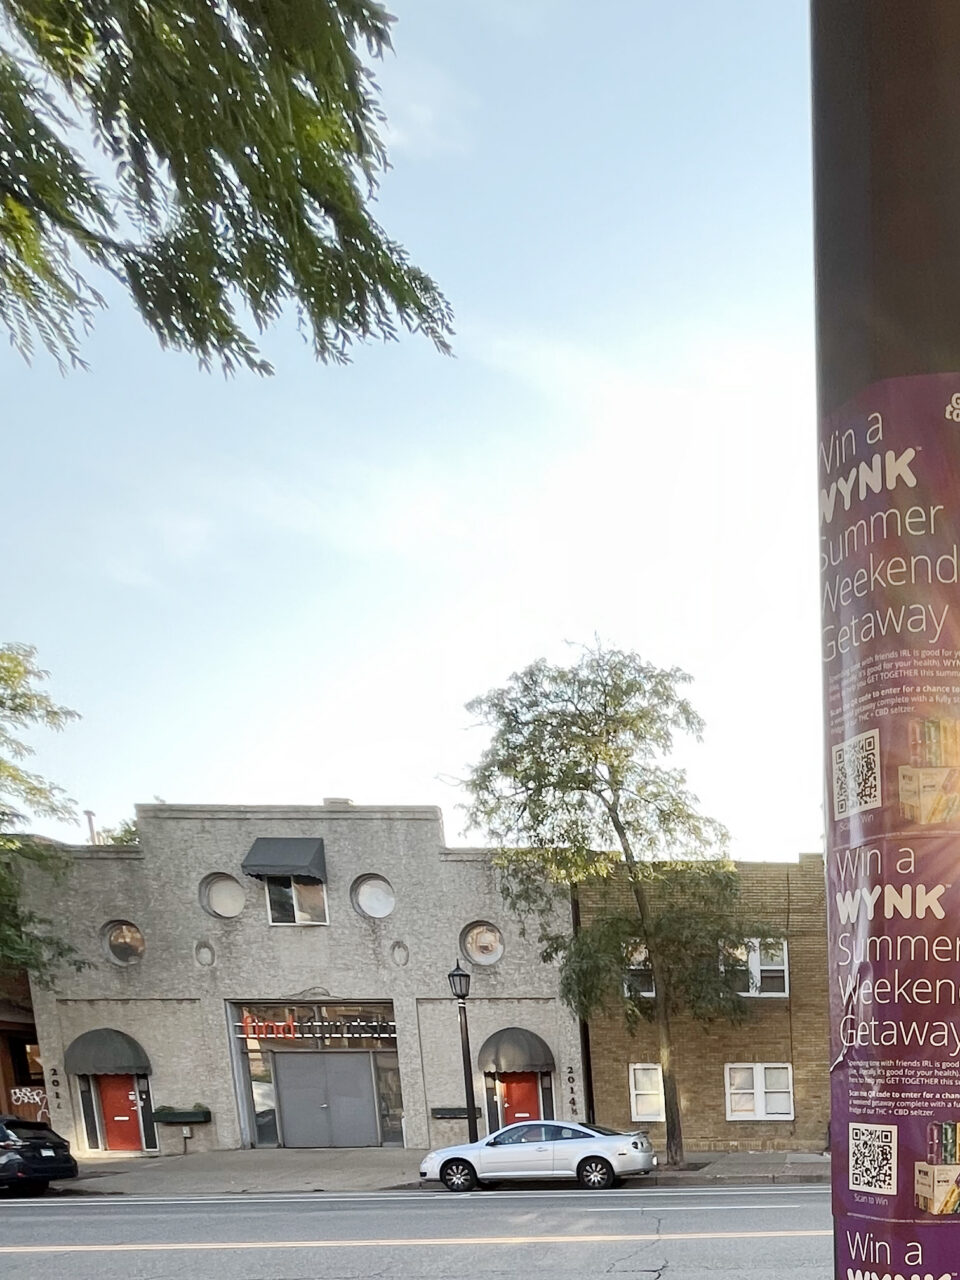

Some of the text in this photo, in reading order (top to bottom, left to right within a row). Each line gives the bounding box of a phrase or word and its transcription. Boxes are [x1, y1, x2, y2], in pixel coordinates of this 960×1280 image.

[866, 412, 883, 444] a
[822, 604, 949, 662] Getaway
[874, 651, 898, 661] friends
[899, 649, 911, 657] IRL
[913, 649, 920, 657] is
[920, 649, 940, 659] good
[942, 649, 953, 657] for
[883, 661, 893, 670] for
[895, 660, 911, 669] your
[866, 674, 879, 684] GET
[880, 668, 919, 681] TOGETHER
[921, 669, 934, 677] this
[872, 690, 880, 698] to
[881, 687, 901, 696] enter
[902, 685, 915, 693] for
[922, 685, 951, 693] chance
[952, 685, 960, 693] to
[877, 697, 909, 707] complete
[911, 695, 927, 704] with
[875, 707, 889, 717] CBD
[836, 847, 915, 881] Win a
[836, 884, 946, 925] WYNK
[242, 1014, 296, 1040] find
[941, 1061, 960, 1069] good
[885, 1069, 904, 1077] good
[901, 1077, 939, 1085] TOGETHER
[922, 1091, 934, 1099] for
[893, 1108, 909, 1116] CBD
[854, 1193, 868, 1203] Scan
[875, 1196, 889, 1206] Win
[846, 1230, 923, 1266] Win a
